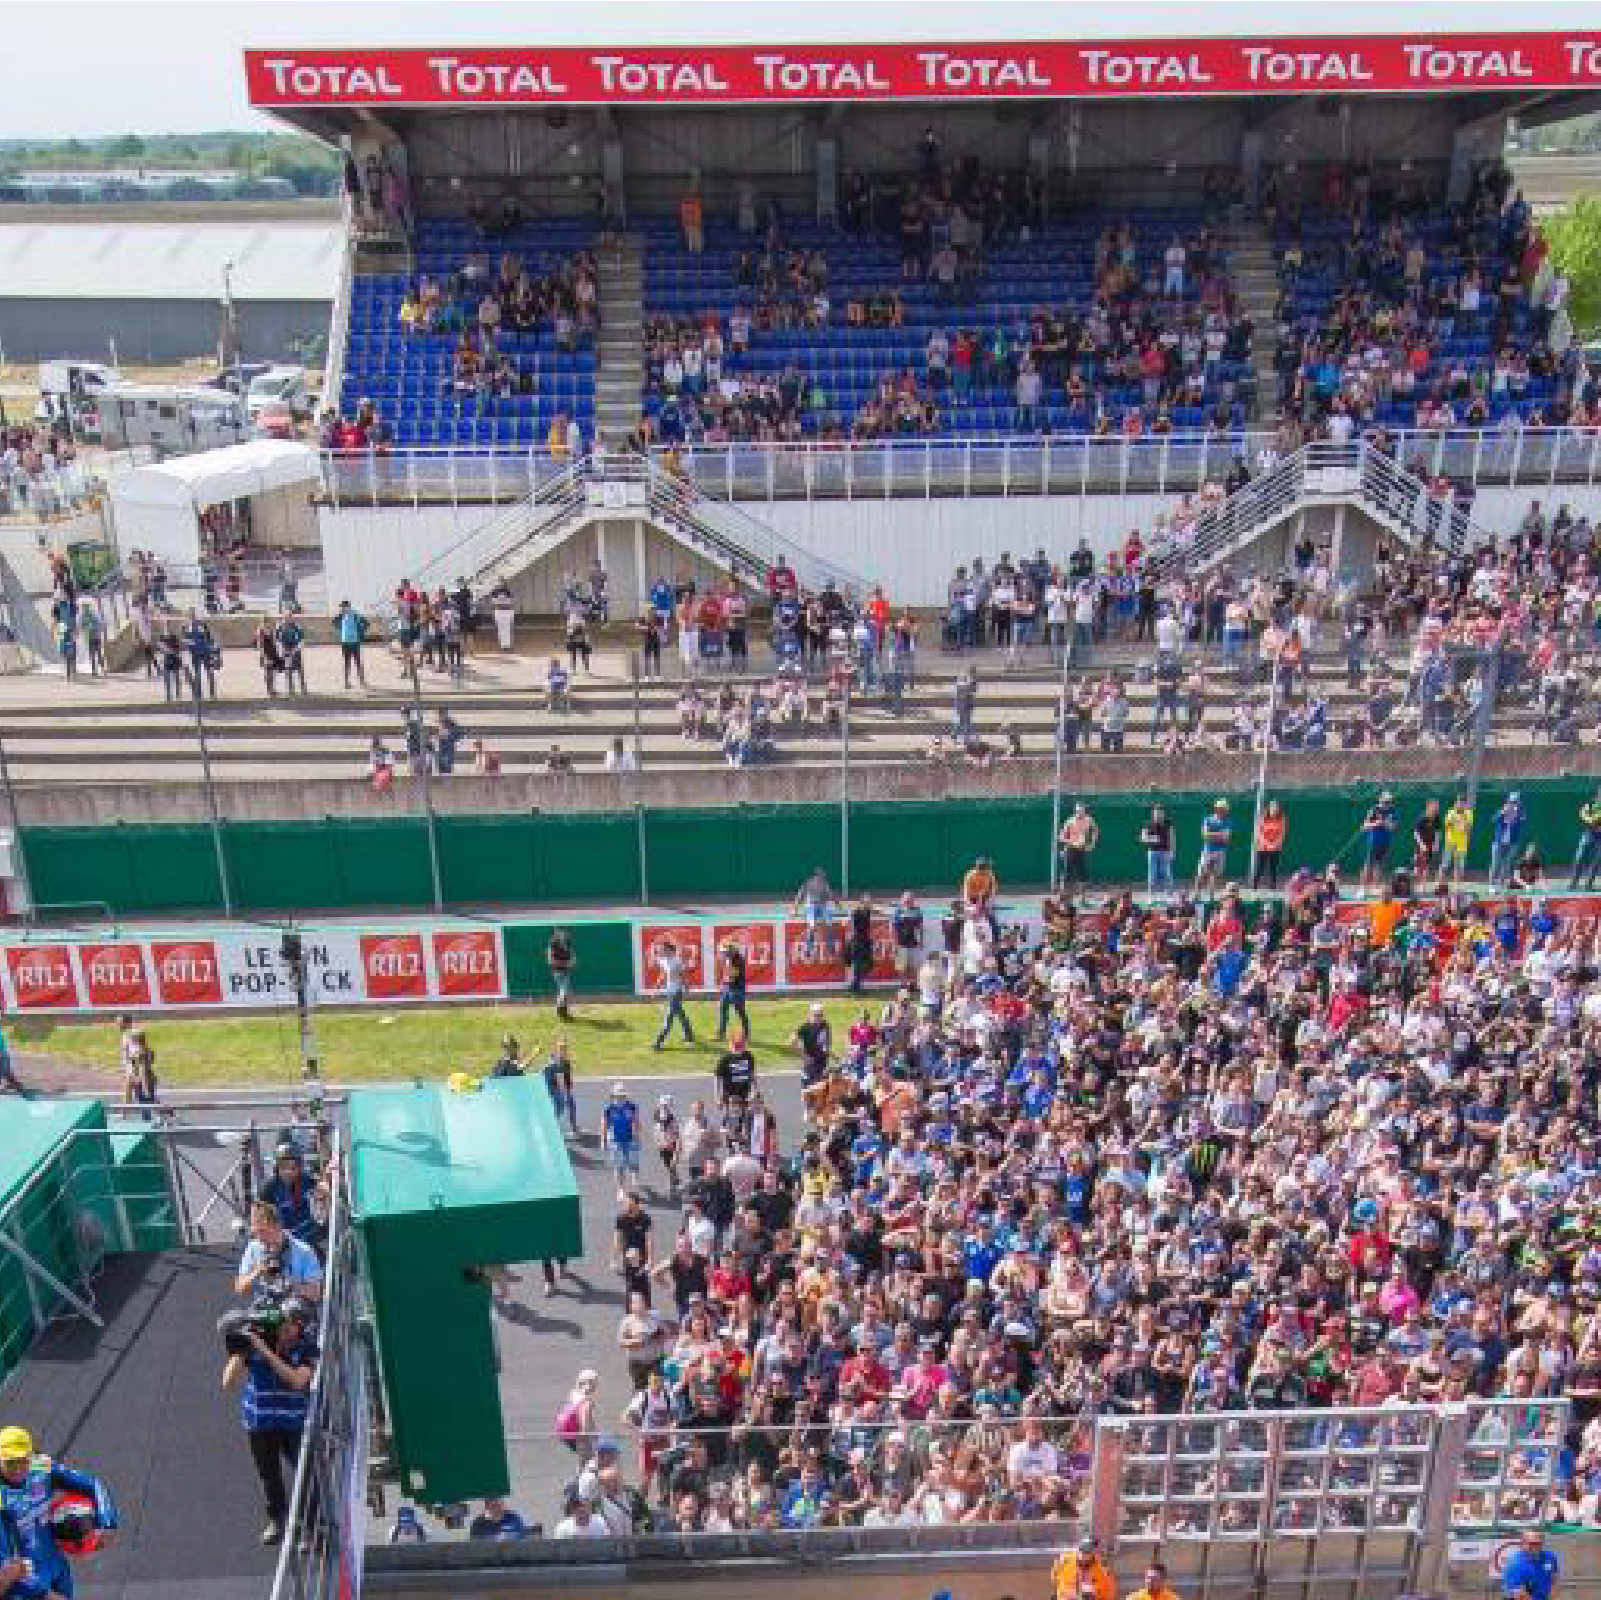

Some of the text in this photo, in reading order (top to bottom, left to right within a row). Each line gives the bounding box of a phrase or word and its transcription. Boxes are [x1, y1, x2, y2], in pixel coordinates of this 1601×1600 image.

[264, 58, 401, 95] TOTAL
[427, 57, 566, 93] TOTAL
[592, 55, 728, 92] TOTAL
[754, 53, 889, 90] TOTAL
[917, 51, 1050, 87] TOTAL
[1080, 49, 1212, 84] TOTAL
[1241, 47, 1373, 81] TOTAL
[1404, 44, 1533, 78] TOTAL
[244, 947, 271, 969] LE
